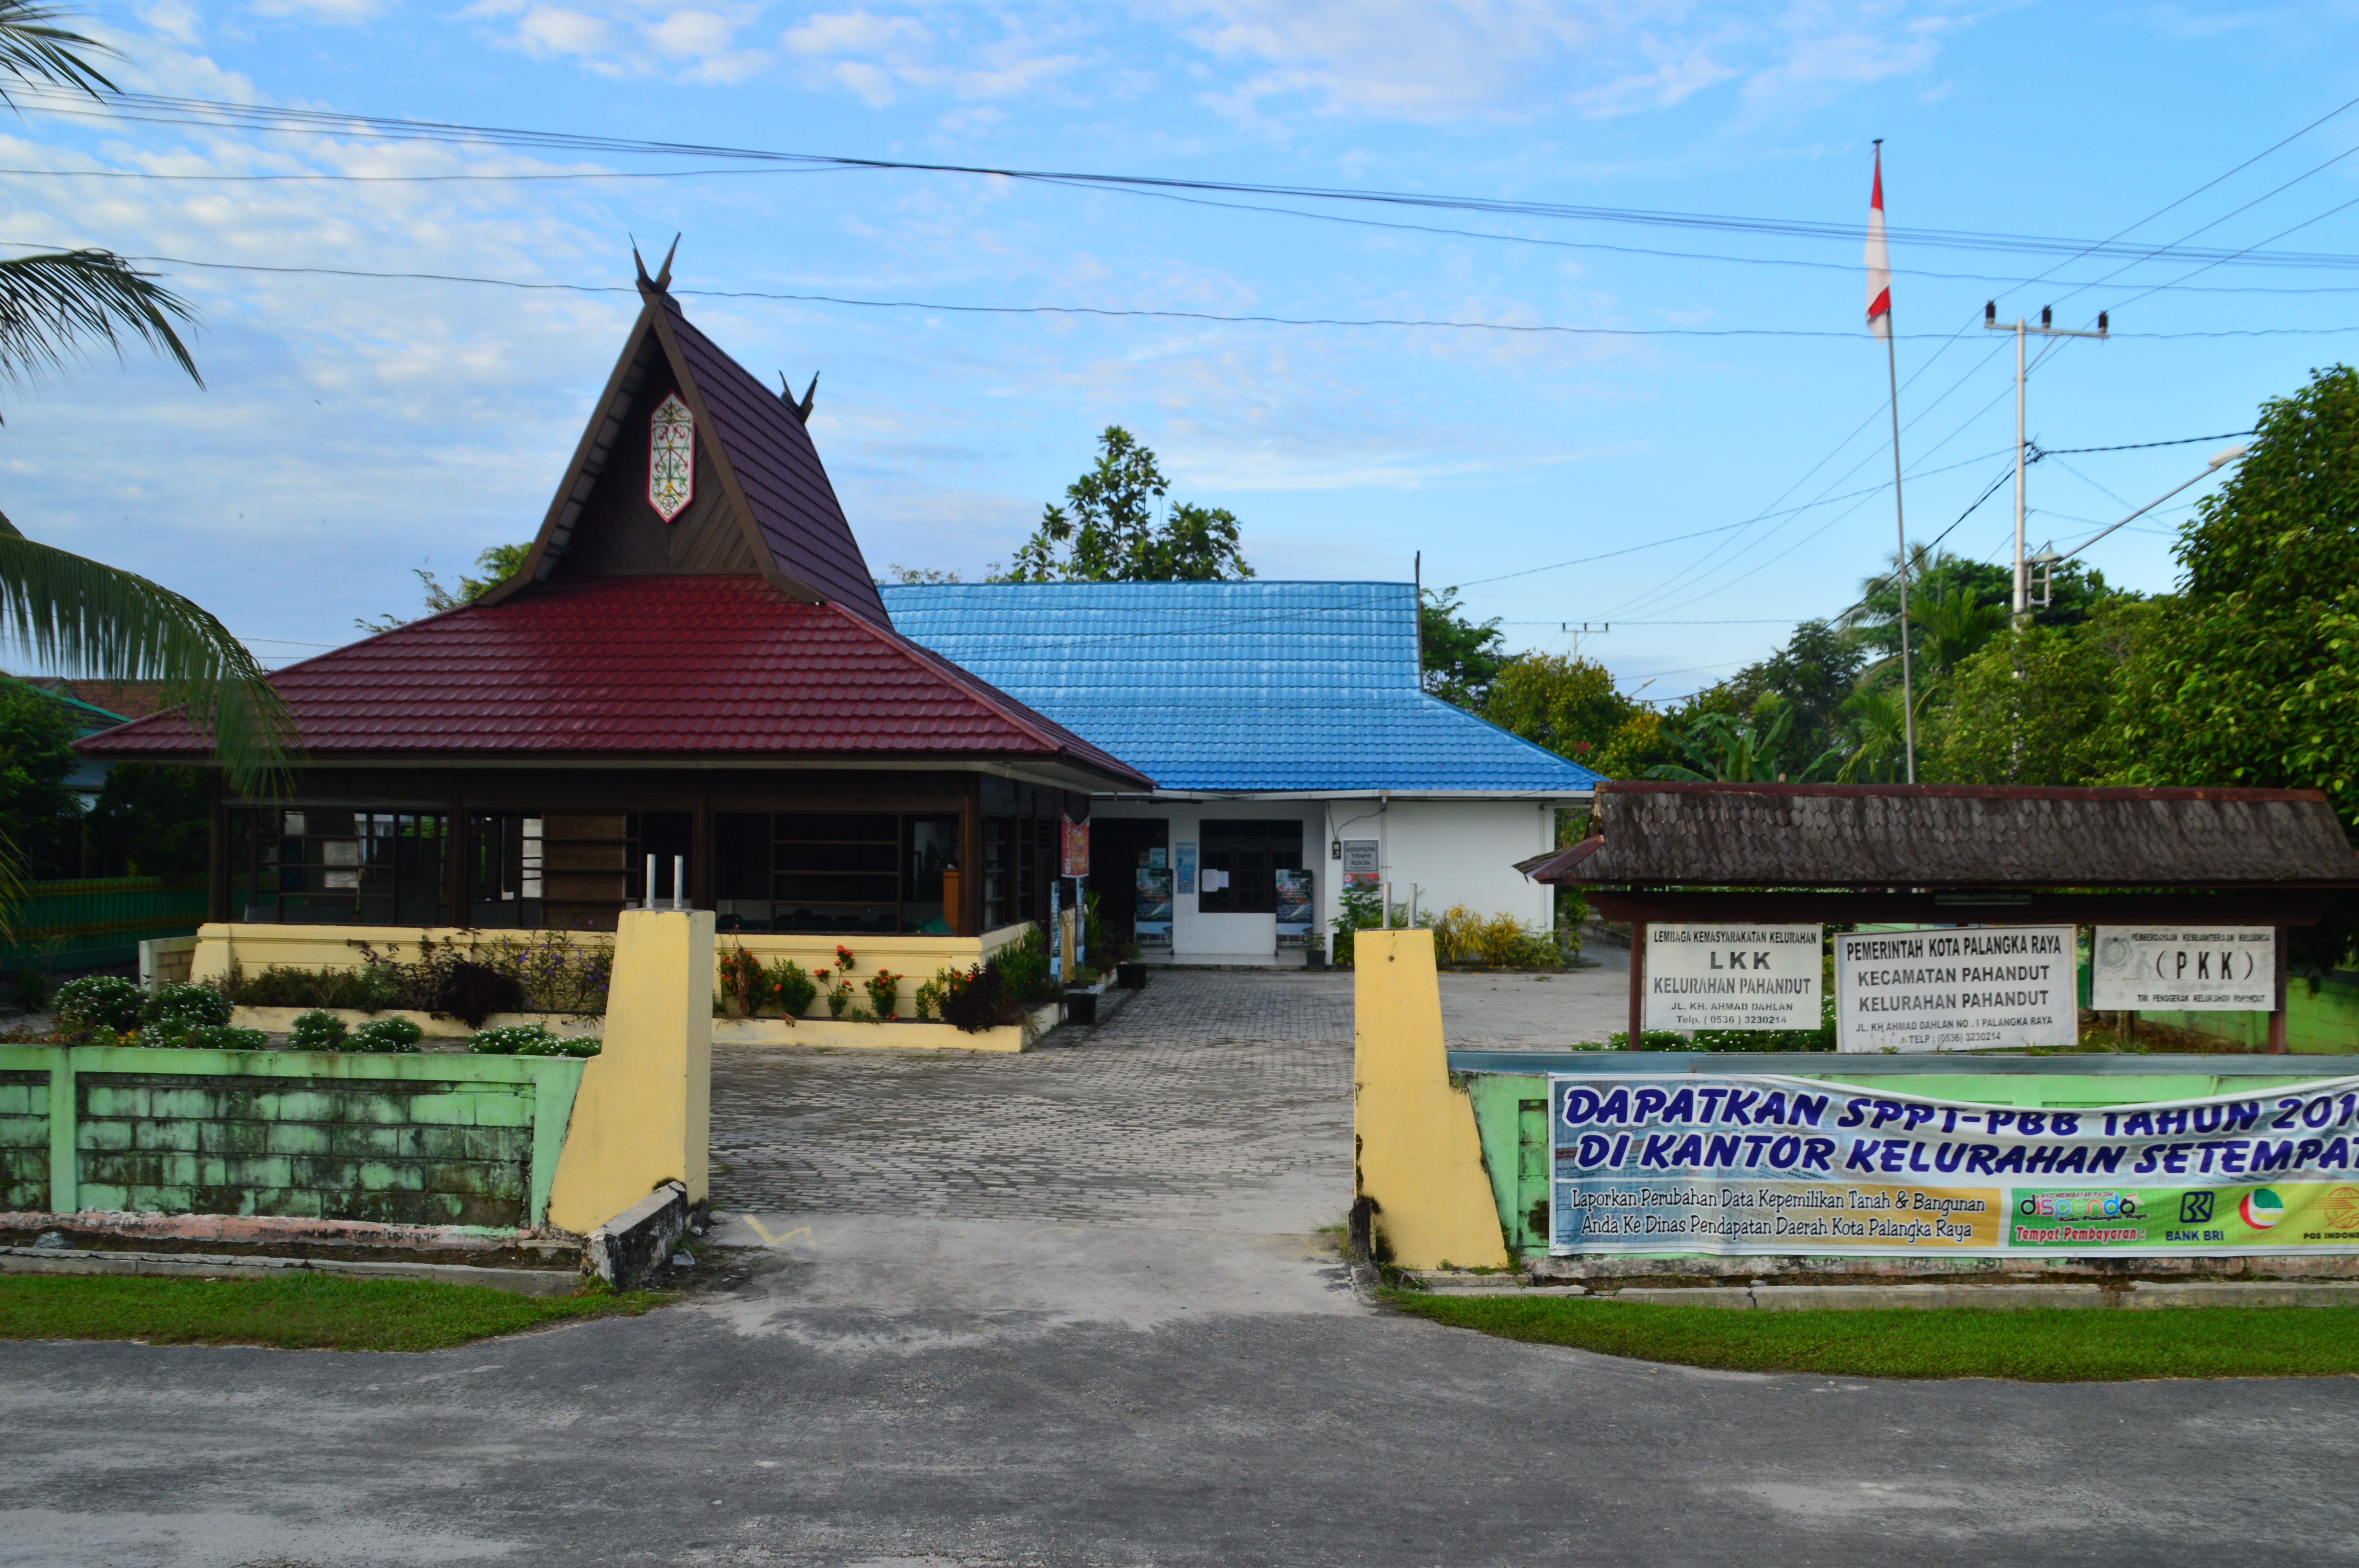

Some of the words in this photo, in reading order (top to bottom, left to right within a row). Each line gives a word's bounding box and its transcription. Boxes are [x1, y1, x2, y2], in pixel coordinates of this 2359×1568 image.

[1654, 931, 1691, 942] LEMBAGA
[1694, 931, 1766, 943] KEMASYARAKATAN
[1770, 931, 1816, 944] KELURAHAN
[2132, 933, 2177, 941] PEMBERDAYAAN
[2183, 933, 2234, 941] KESEJAHTERAAN
[1847, 940, 1923, 961] PEMERINTAH
[1929, 937, 1960, 956] KOTA
[1964, 935, 2028, 955] PALANGKA
[2032, 935, 2061, 954] RAYA
[1858, 968, 1956, 986] KECAMATAN
[1962, 965, 2050, 982] PAHANDUT
[1654, 977, 1735, 994] KELURAHAN
[1740, 978, 1810, 994] PAHANDUT
[1859, 994, 1956, 1012] KELURAHAN
[1962, 990, 2048, 1008] PAHANDUT
[1677, 1016, 1700, 1024] Telp.
[1886, 1022, 1917, 1031] AHMAD
[1920, 1020, 1953, 1029] DAHLAN
[1983, 1017, 2028, 1027] PALANGKA
[2030, 1016, 2053, 1025] RAYA
[1966, 1032, 2001, 1041] 3230214
[1566, 1088, 1830, 1127] DAPATKAN
[1837, 1098, 2082, 1136] SPPT-PBB
[2101, 1102, 2261, 1136] TAHUN
[2271, 1094, 2359, 1129] 201
[1578, 1134, 1630, 1167] DI
[1641, 1133, 1836, 1171] KANTOR
[1845, 1139, 2127, 1175] KELURAHAN
[1572, 1189, 1637, 1211] Laporkan
[1642, 1188, 1717, 1207] Perubahan
[1722, 1189, 1753, 1207] Data
[1759, 1189, 1844, 1212] Kepemilikan
[1849, 1191, 1890, 1209] Tanah
[1896, 1191, 1909, 1209] &
[1913, 1193, 1985, 1216] Bangunan
[1581, 1215, 1618, 1234] Anda
[1623, 1216, 1641, 1233] Ke
[1645, 1215, 1685, 1233] Dinas
[1690, 1216, 1771, 1240] Pendapatan
[1776, 1217, 1828, 1235] Daerah
[1832, 1218, 1864, 1236] Kota
[1869, 1219, 1931, 1242] Palangka
[1936, 1221, 1972, 1242] Raya
[2017, 1227, 2059, 1243] Tempat
[2064, 1227, 2137, 1243] Pembayaran
[2166, 1231, 2200, 1241] BANK
[2204, 1230, 2224, 1241] BRI
